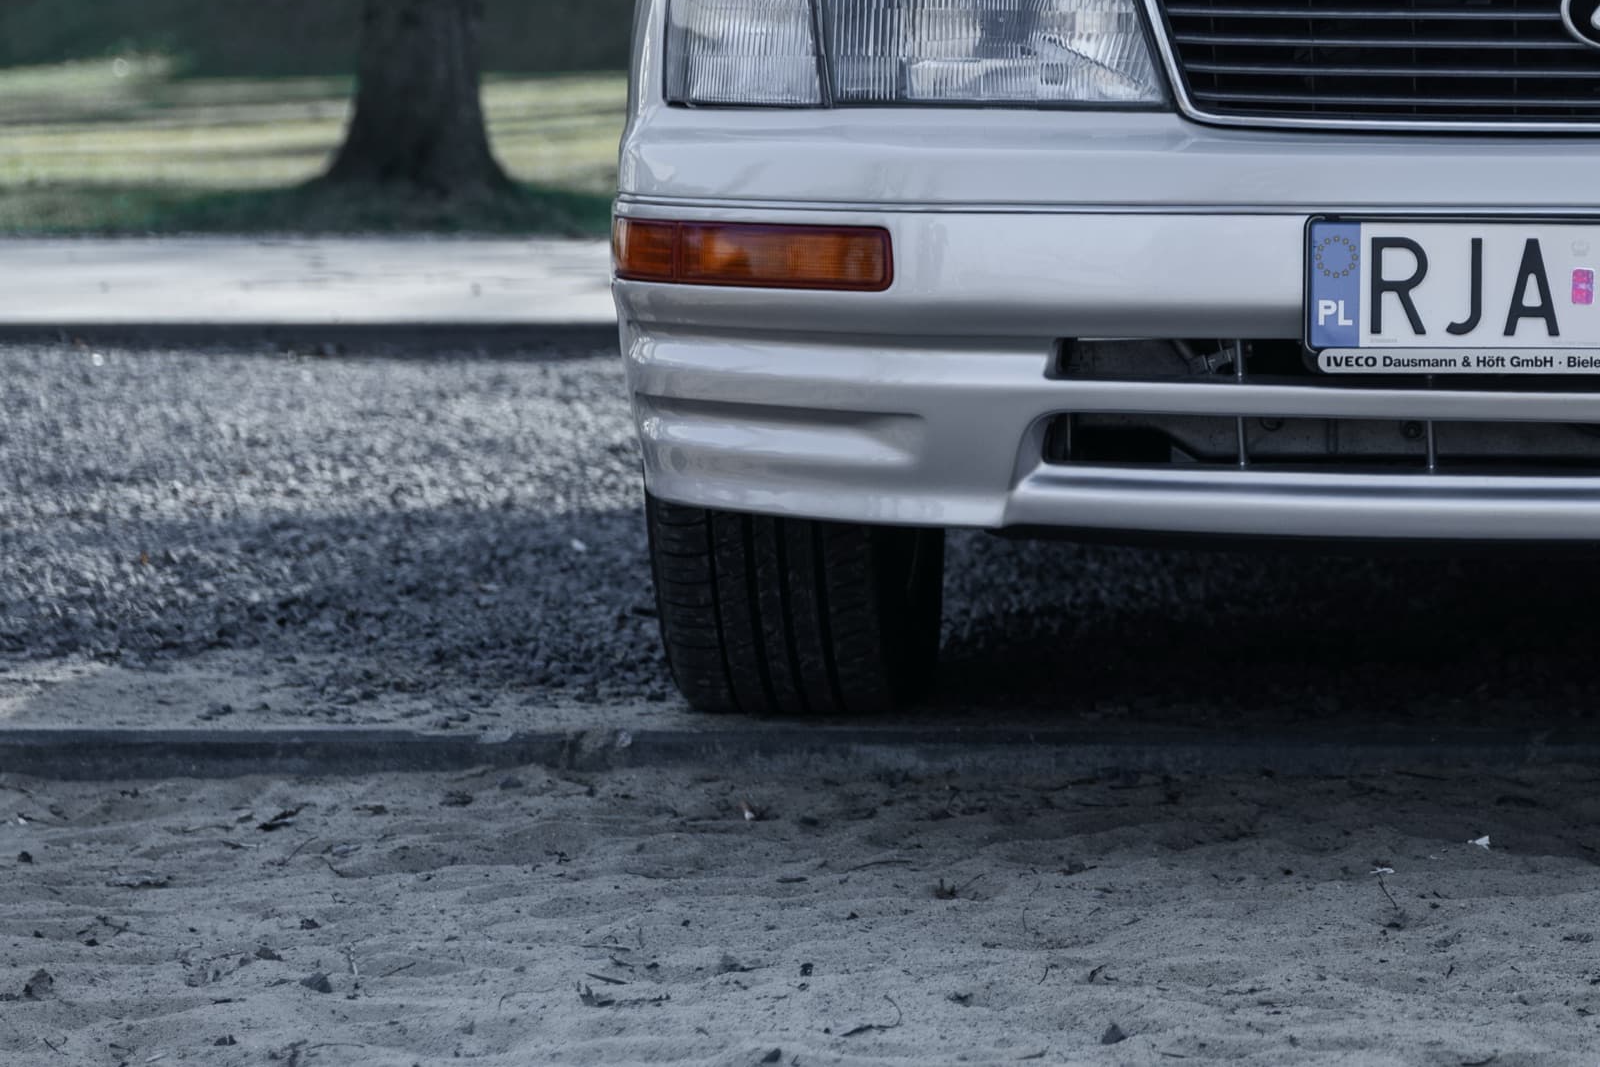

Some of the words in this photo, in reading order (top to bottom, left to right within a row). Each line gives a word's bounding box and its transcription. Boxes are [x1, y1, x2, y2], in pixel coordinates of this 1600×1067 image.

[1370, 236, 1561, 337] RJA
[1318, 299, 1353, 326] PL
[1326, 355, 1378, 368] IVECO
[1382, 355, 1457, 368] Dausmann
[1461, 355, 1472, 368] &
[1476, 355, 1506, 368] Höft
[1509, 355, 1554, 368] GmbH
